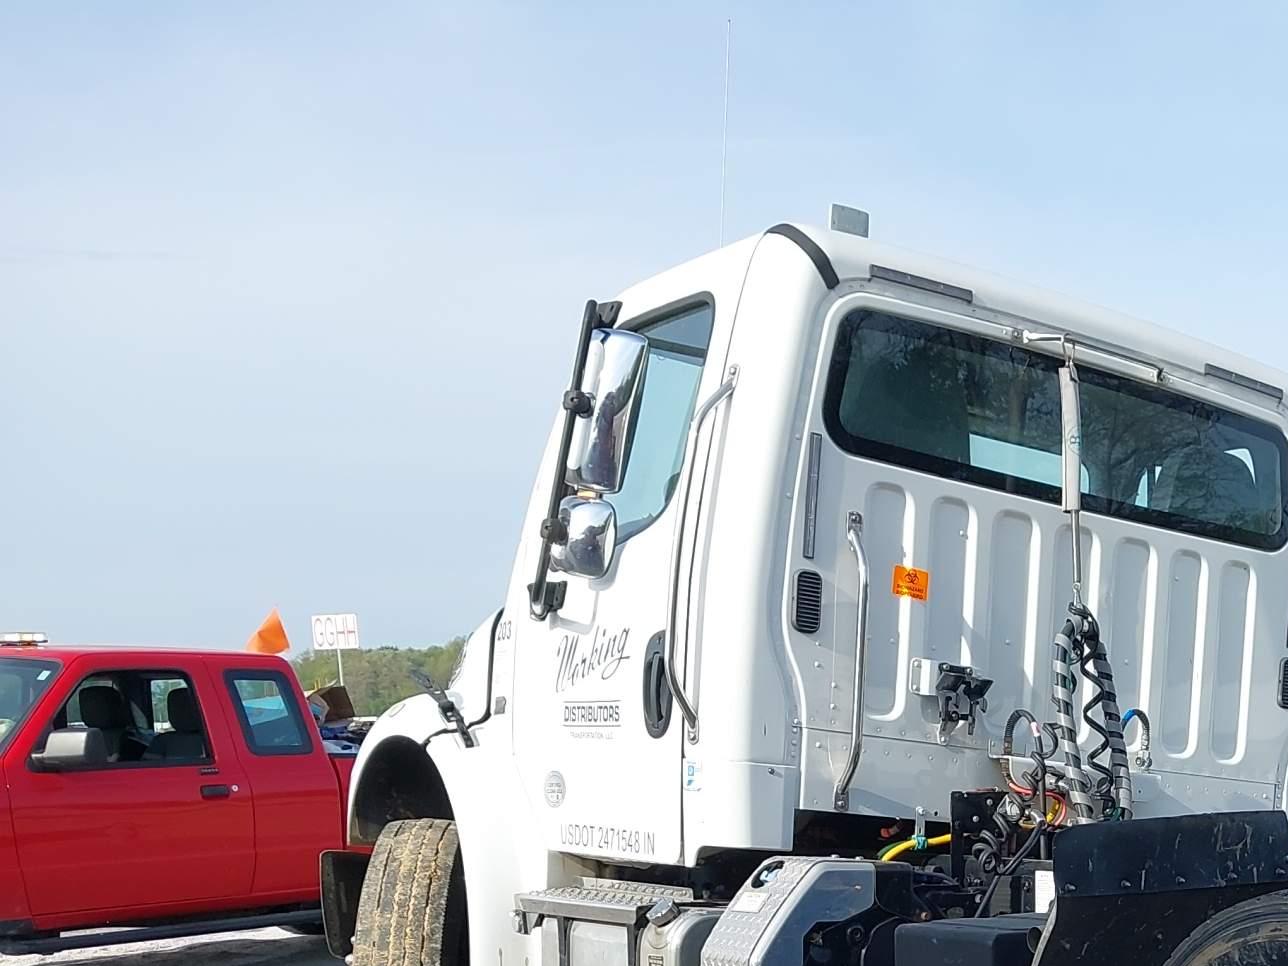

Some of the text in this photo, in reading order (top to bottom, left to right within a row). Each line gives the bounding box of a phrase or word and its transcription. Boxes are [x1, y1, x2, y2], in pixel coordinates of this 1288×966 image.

[563, 705, 620, 723] DISTRIBUTORS
[560, 823, 655, 855] USDOT 2471548 IN
